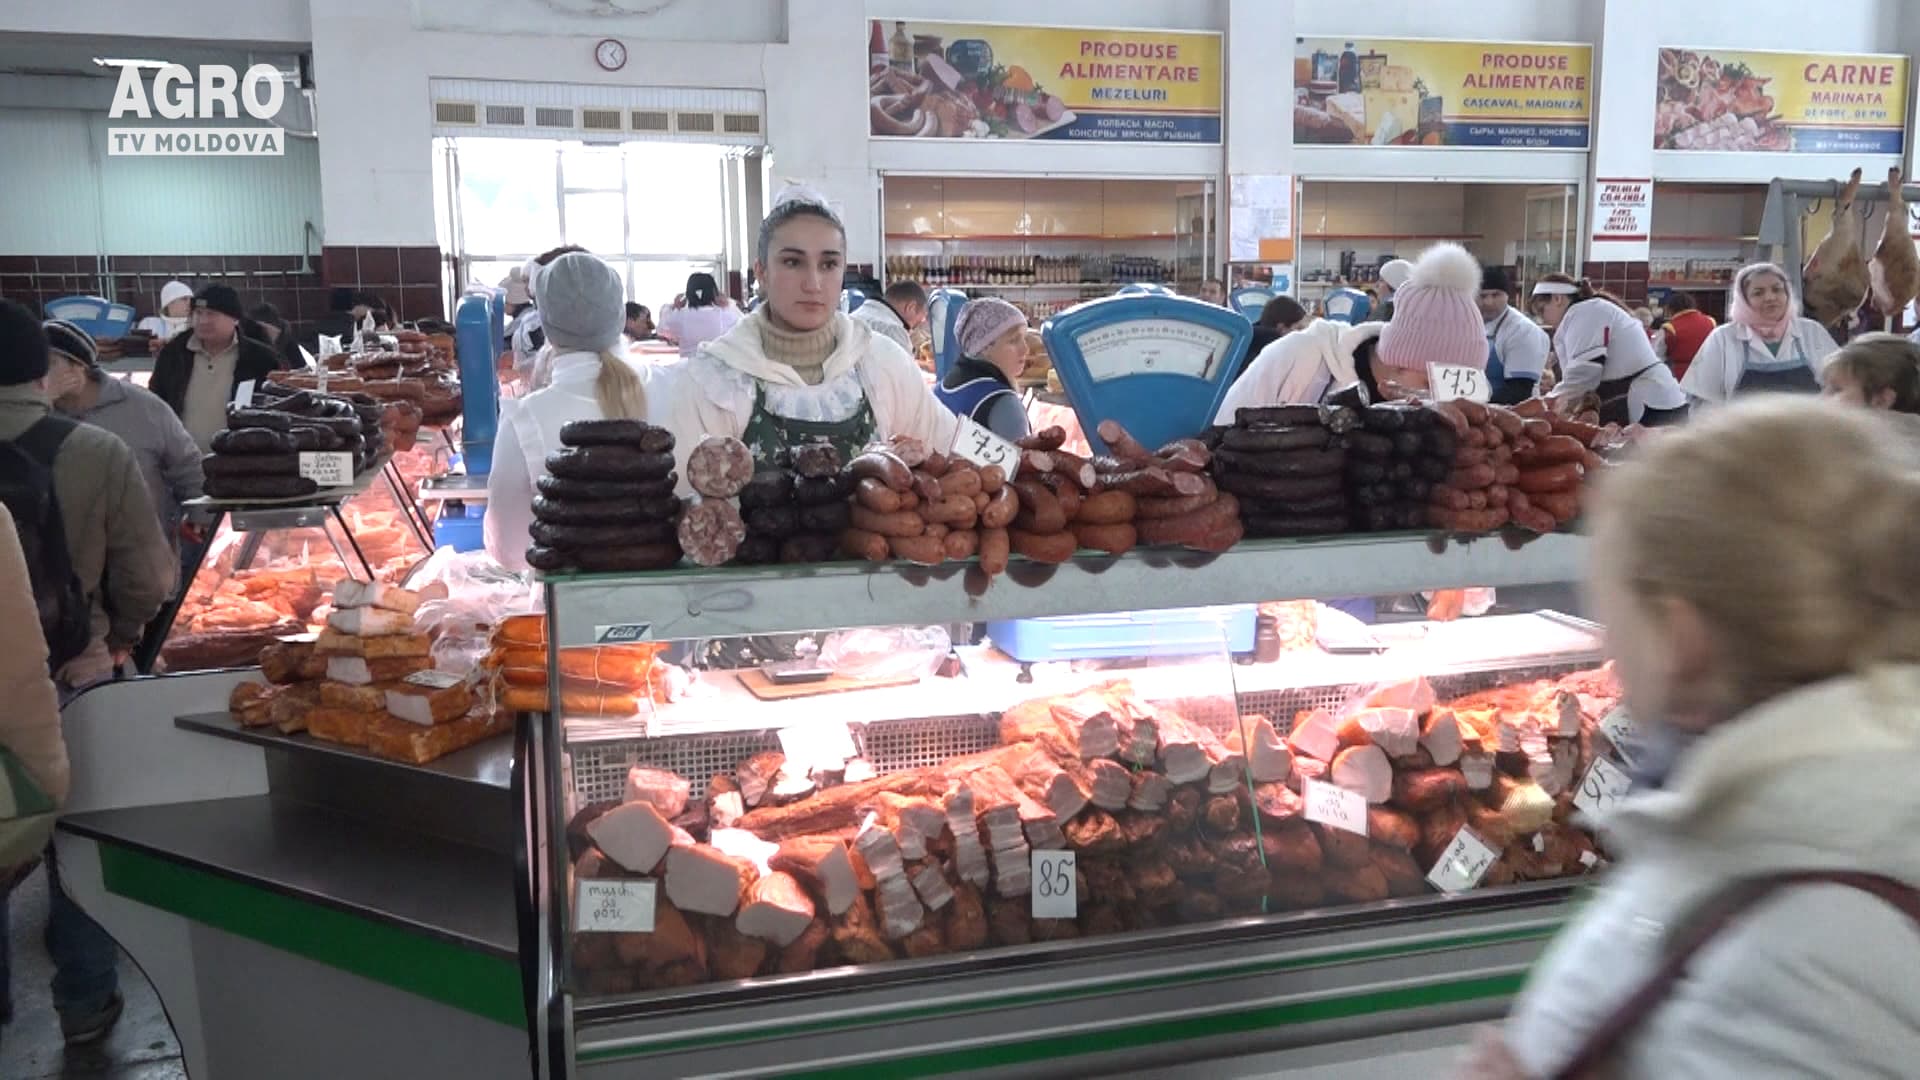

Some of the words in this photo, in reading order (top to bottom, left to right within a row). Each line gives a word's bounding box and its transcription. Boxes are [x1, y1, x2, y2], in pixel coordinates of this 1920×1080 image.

[1080, 40, 1178, 59] PRODUSE
[1482, 53, 1568, 70] PRODUSE
[1059, 62, 1200, 82] ALIMENTARE
[1804, 63, 1894, 85] CARNE
[1462, 73, 1585, 91] ALIMENTARE
[1091, 87, 1167, 101] MEZELURI
[1811, 91, 1883, 105] MARINATA
[1039, 858, 1074, 898] 85
